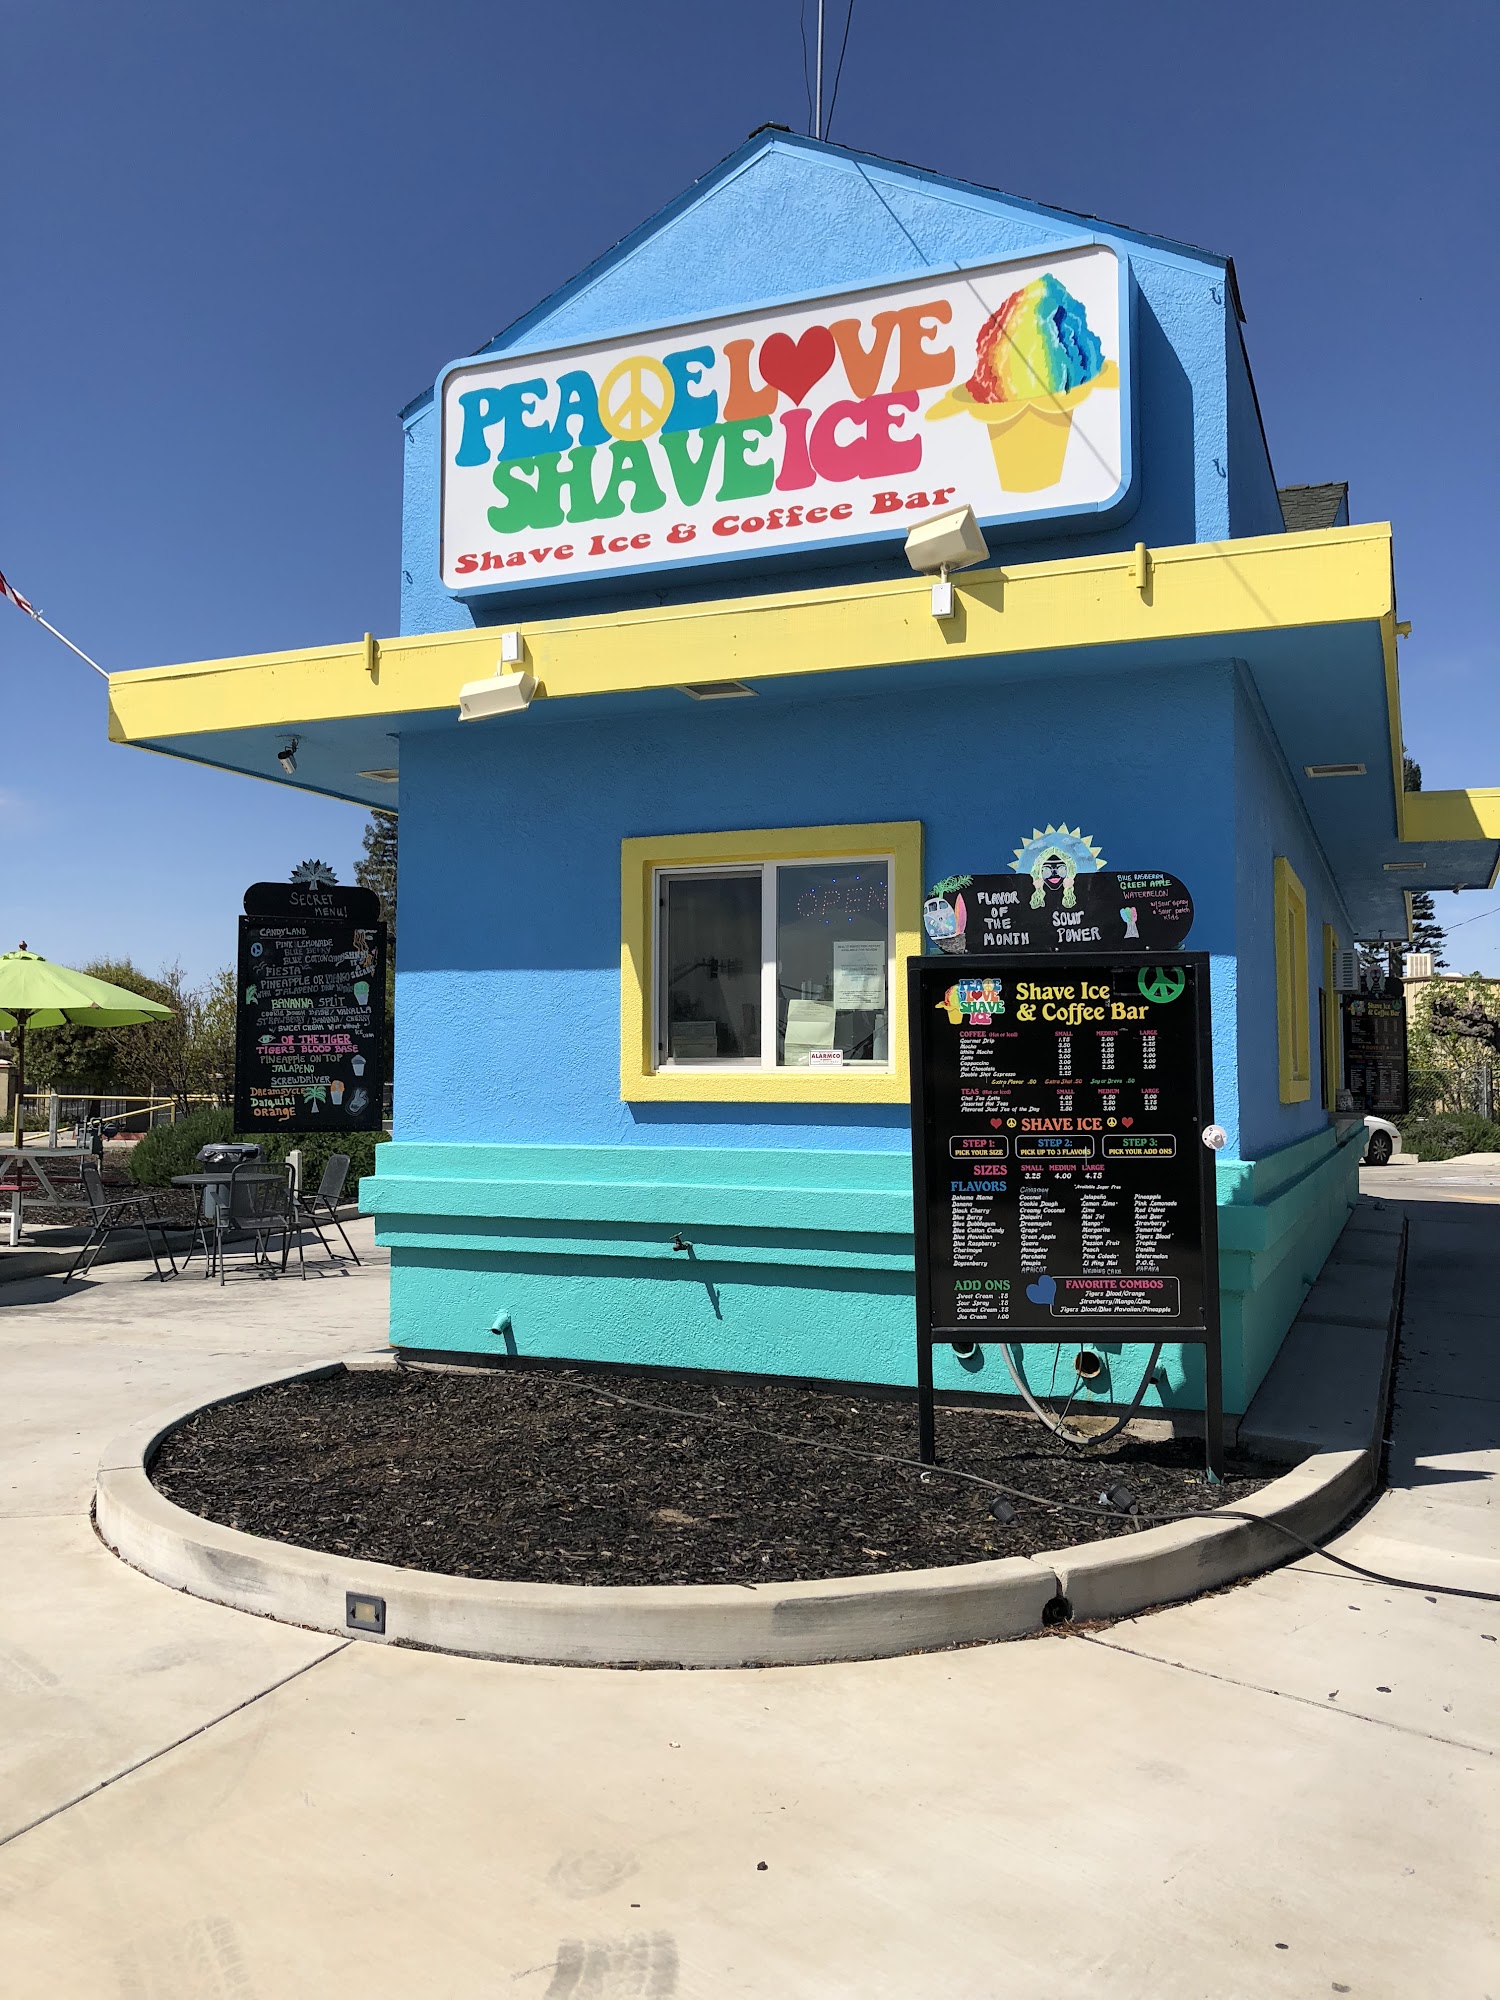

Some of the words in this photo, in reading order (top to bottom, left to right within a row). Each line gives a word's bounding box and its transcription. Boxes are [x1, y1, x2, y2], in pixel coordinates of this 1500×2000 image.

[487, 414, 774, 534] SHAVE
[775, 390, 922, 493] ICE
[455, 539, 573, 574] Shave
[587, 532, 651, 556] Ice
[666, 522, 696, 543] &
[712, 497, 853, 538] Coffee
[870, 485, 956, 515] Bar
[1120, 881, 1146, 890] GREEN
[1150, 879, 1172, 887] APPLE
[289, 892, 333, 905] SECRET
[977, 891, 1020, 905] FLAVOR
[1123, 889, 1168, 899] WATERMELON
[797, 885, 887, 916] OPEN
[315, 906, 347, 917] MENU!
[991, 906, 1008, 918] OF
[984, 918, 1011, 929] THE
[984, 933, 1029, 945] MONTH
[1057, 927, 1101, 942] POWER
[275, 941, 293, 950] PINK
[297, 939, 333, 948] LEMONADE
[261, 976, 311, 989] PINEAPPLE
[313, 975, 324, 984] OR
[1016, 983, 1075, 1000] Shave
[1081, 982, 1110, 1000] Ice
[271, 998, 313, 1009] BANANNA
[959, 1001, 1005, 1014] SHAVE
[969, 1013, 991, 1025] ICE
[1017, 1004, 1039, 1021] &
[1042, 1003, 1105, 1025] Coffee
[1111, 1002, 1149, 1019] Bar
[281, 1035, 295, 1045] OF
[298, 1035, 321, 1044] THE
[321, 1034, 351, 1044] TIGER
[256, 1046, 295, 1054] TIGERS
[301, 1045, 331, 1053] BLOOD
[334, 1044, 358, 1053] BASE
[322, 1054, 343, 1062] TOP
[272, 1064, 314, 1073] JALAPENO
[1022, 1118, 1073, 1131] SHAVE
[1077, 1118, 1102, 1130] ICE
[1038, 1139, 1062, 1147] STEP
[1064, 1139, 1072, 1147] 2:
[1123, 1138, 1147, 1146] STEP
[1149, 1138, 1157, 1146] 3:
[1062, 1148, 1091, 1156] FLAVORS
[974, 1165, 1007, 1175] SIZES
[951, 1181, 1006, 1191] FLAVORS
[954, 1280, 982, 1290] ADD
[985, 1280, 1010, 1290] ONS
[1066, 1280, 1117, 1288] FAVORITE
[1120, 1280, 1163, 1288] COMBOS
